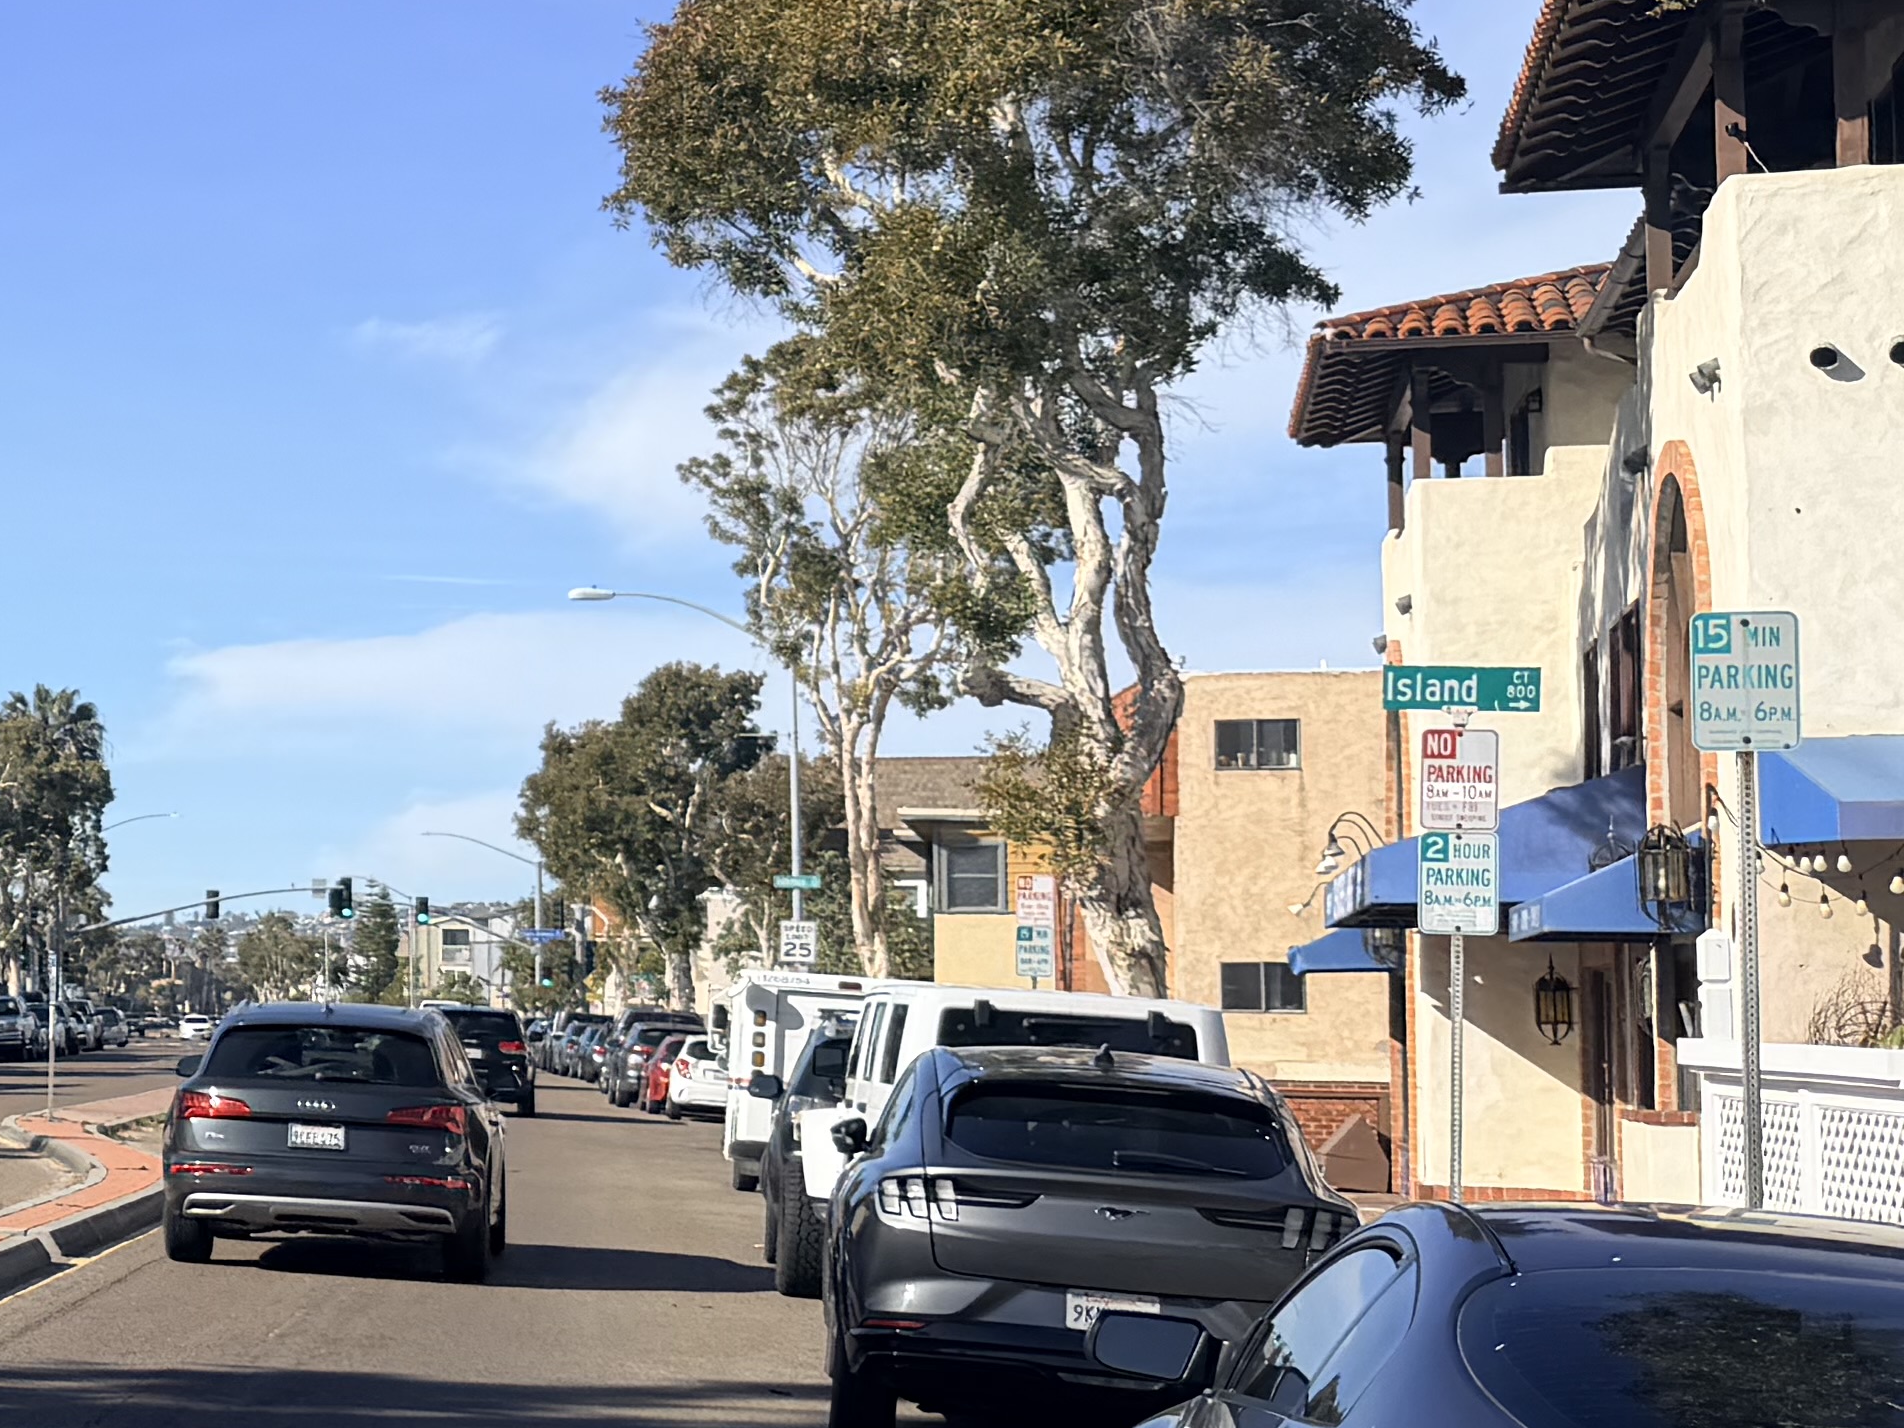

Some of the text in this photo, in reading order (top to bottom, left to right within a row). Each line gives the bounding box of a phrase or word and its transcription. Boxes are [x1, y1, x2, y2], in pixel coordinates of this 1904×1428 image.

[1694, 618, 1781, 649] 15 MIN
[1512, 670, 1530, 684] CT
[1697, 663, 1794, 690] PARKING
[1386, 671, 1478, 703] Island
[1506, 685, 1537, 699] 800
[1426, 732, 1452, 756] NO
[1427, 764, 1493, 784] PARKING
[1426, 836, 1491, 859] 2 HOUR
[1426, 867, 1491, 887] PARKING
[783, 924, 814, 933] SPEED
[783, 941, 812, 958] 25
